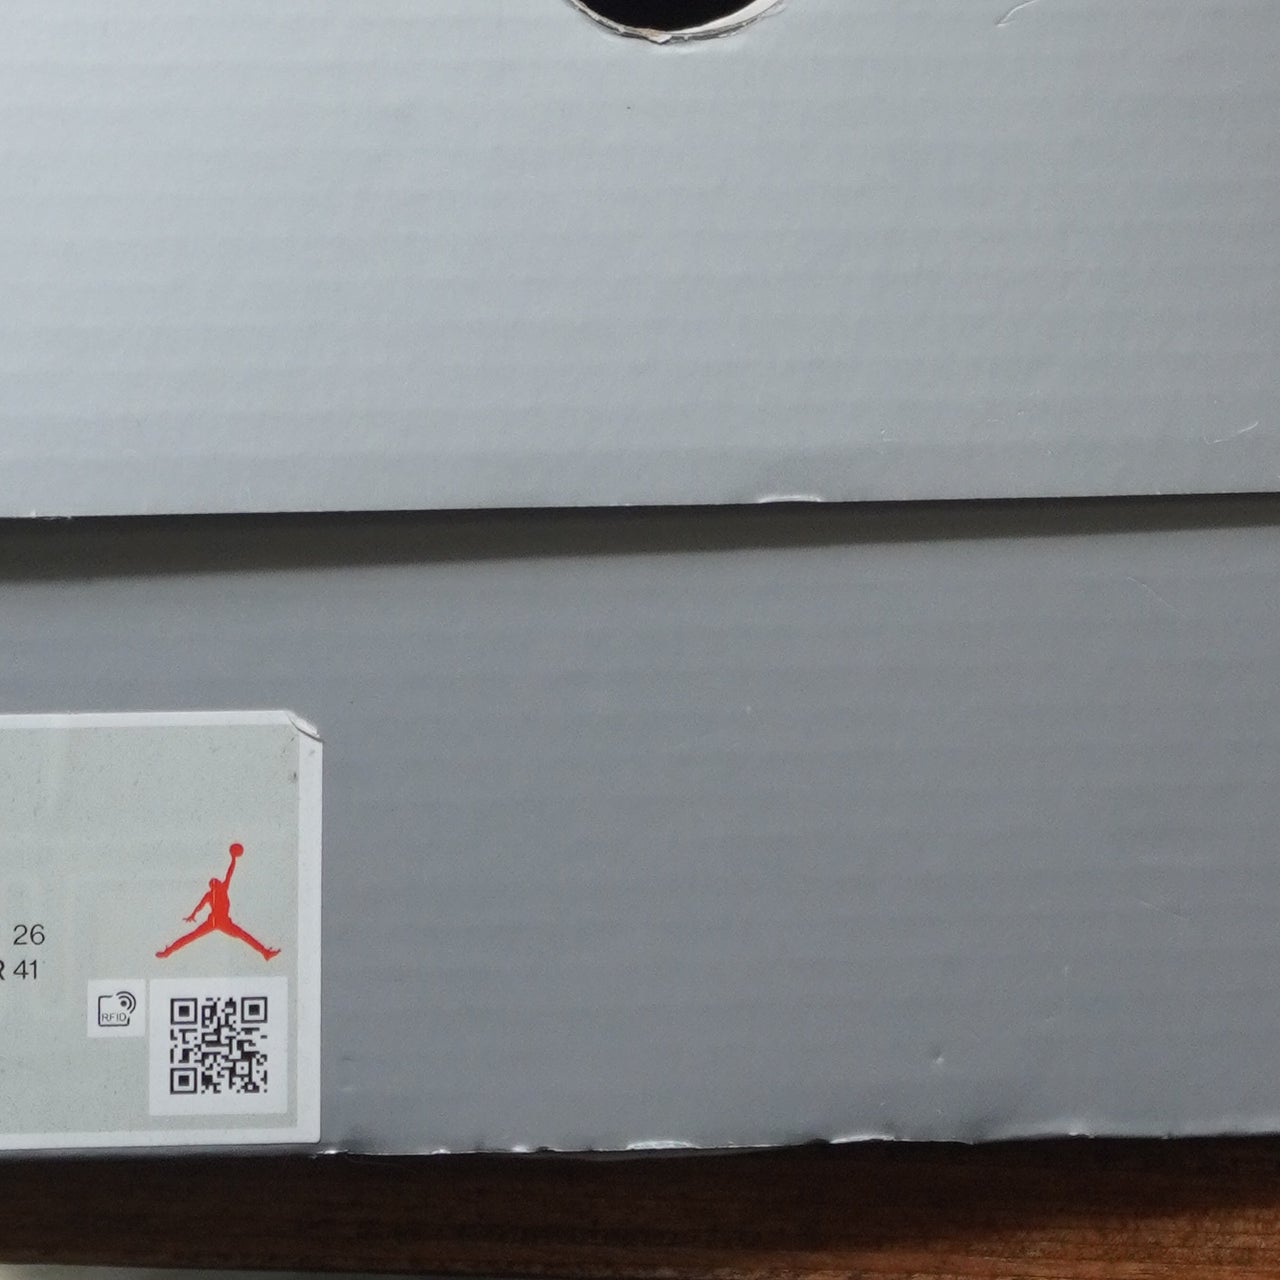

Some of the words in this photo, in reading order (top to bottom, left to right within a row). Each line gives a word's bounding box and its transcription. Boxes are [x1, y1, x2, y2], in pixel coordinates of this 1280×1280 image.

[13, 923, 46, 946] 26
[12, 959, 37, 980] 41
[101, 1012, 127, 1022] RFID
